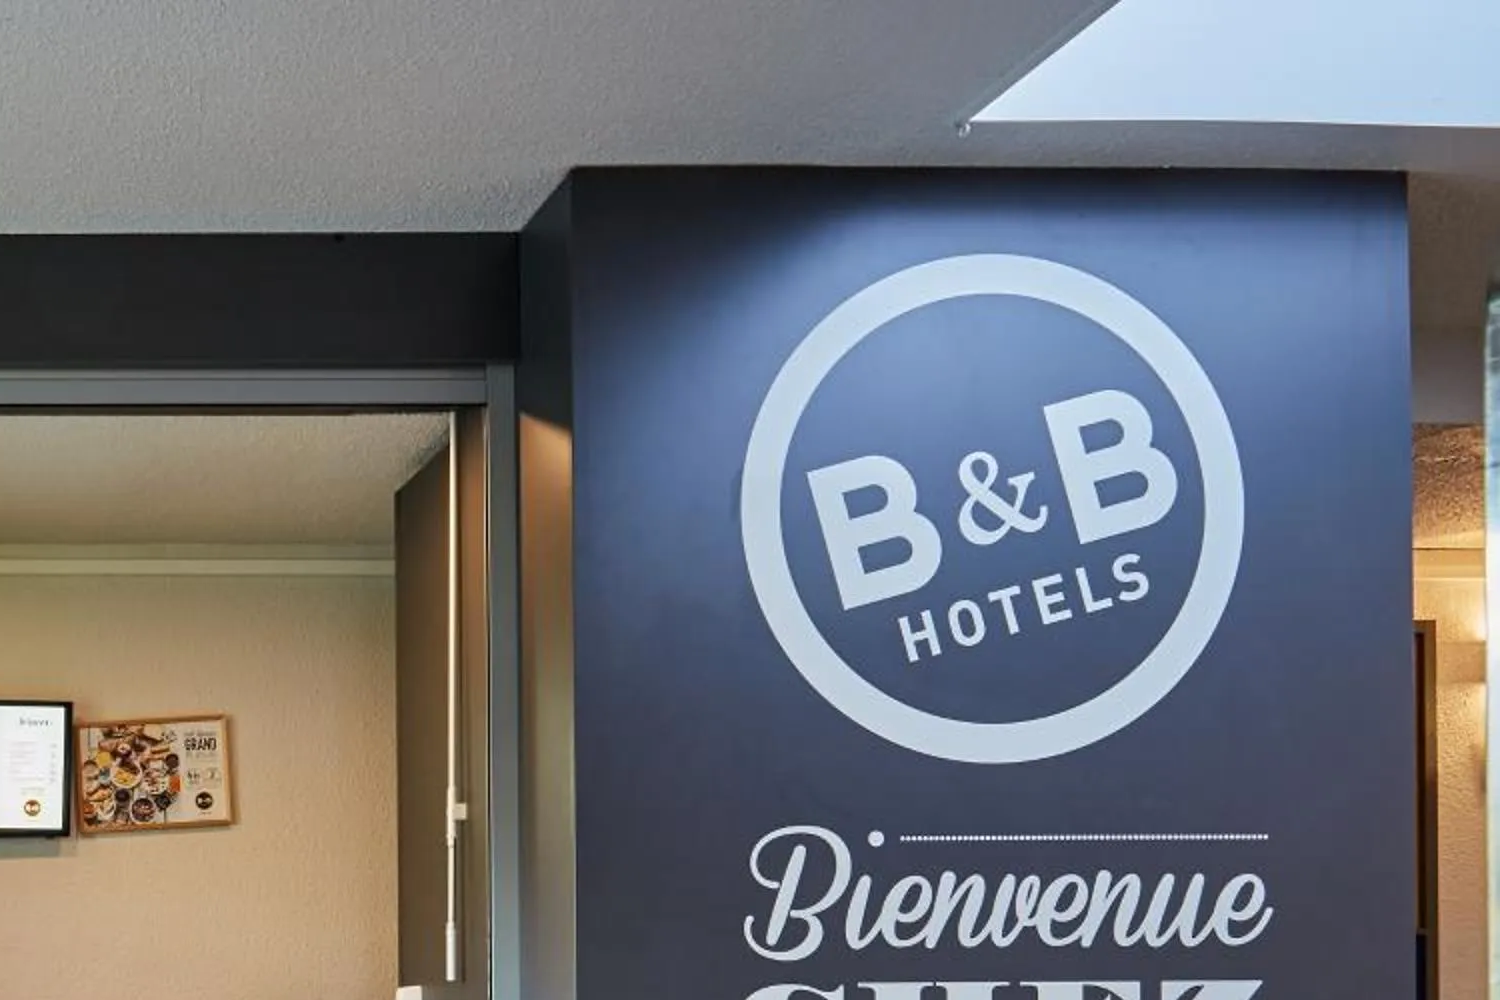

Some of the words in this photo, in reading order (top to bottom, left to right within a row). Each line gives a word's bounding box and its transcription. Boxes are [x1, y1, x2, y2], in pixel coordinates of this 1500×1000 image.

[806, 387, 1179, 611] B&B
[896, 552, 1152, 664] HOTELS
[742, 824, 1275, 962] Bienvenue
